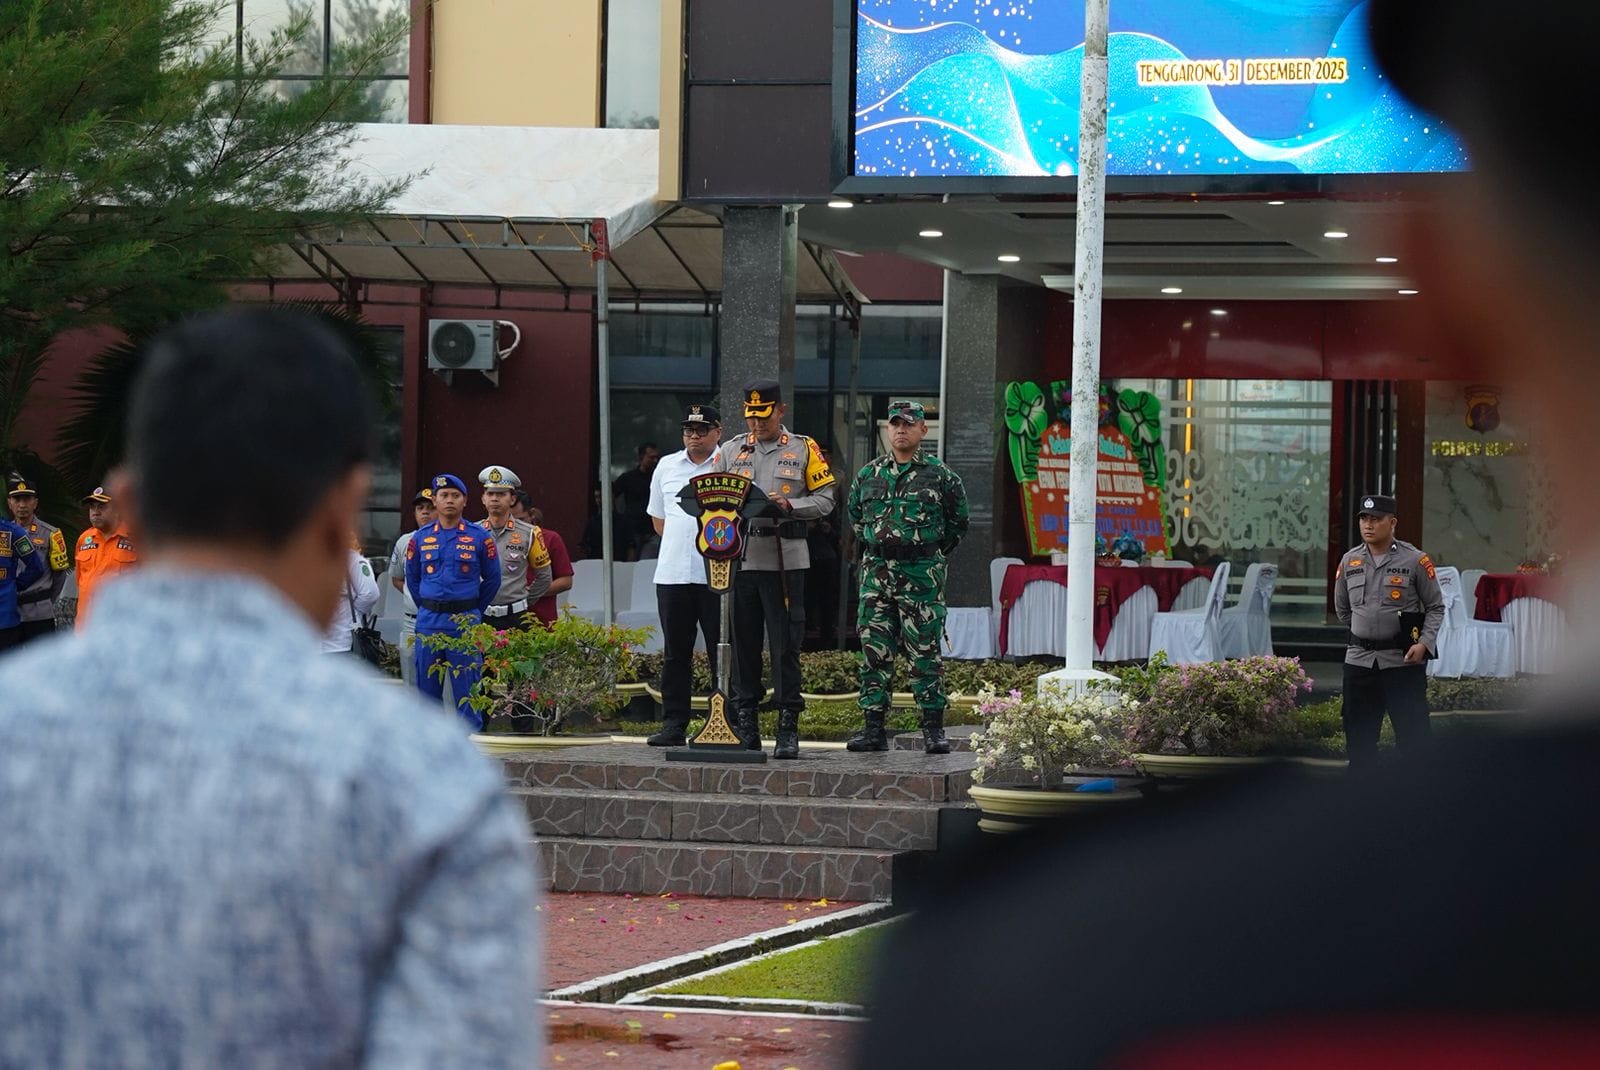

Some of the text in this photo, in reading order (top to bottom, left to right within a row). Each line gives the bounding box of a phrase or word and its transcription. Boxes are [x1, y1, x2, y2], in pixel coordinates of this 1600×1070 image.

[1228, 62, 1239, 81] 31
[1247, 62, 1311, 81] DESEMBER
[1315, 61, 1345, 80] 2025
[696, 477, 745, 489] POLRES
